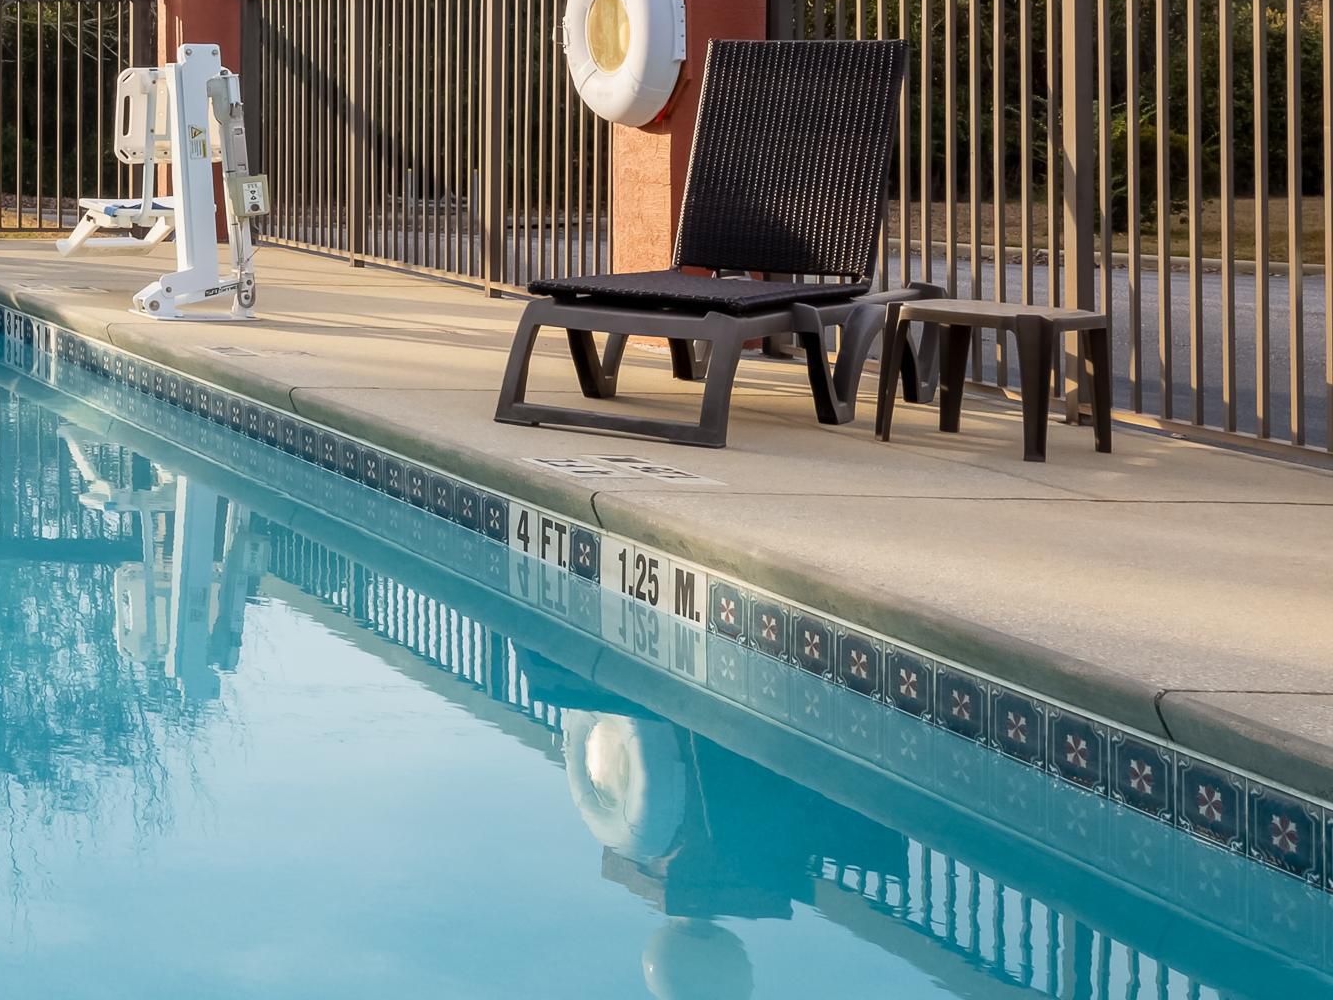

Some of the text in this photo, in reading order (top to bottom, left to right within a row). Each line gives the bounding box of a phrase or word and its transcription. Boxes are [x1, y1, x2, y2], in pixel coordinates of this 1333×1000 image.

[6, 311, 12, 336] 3
[36, 323, 41, 349] 1
[516, 510, 567, 568] 4 FT.
[618, 547, 701, 623] 1.25 M.
